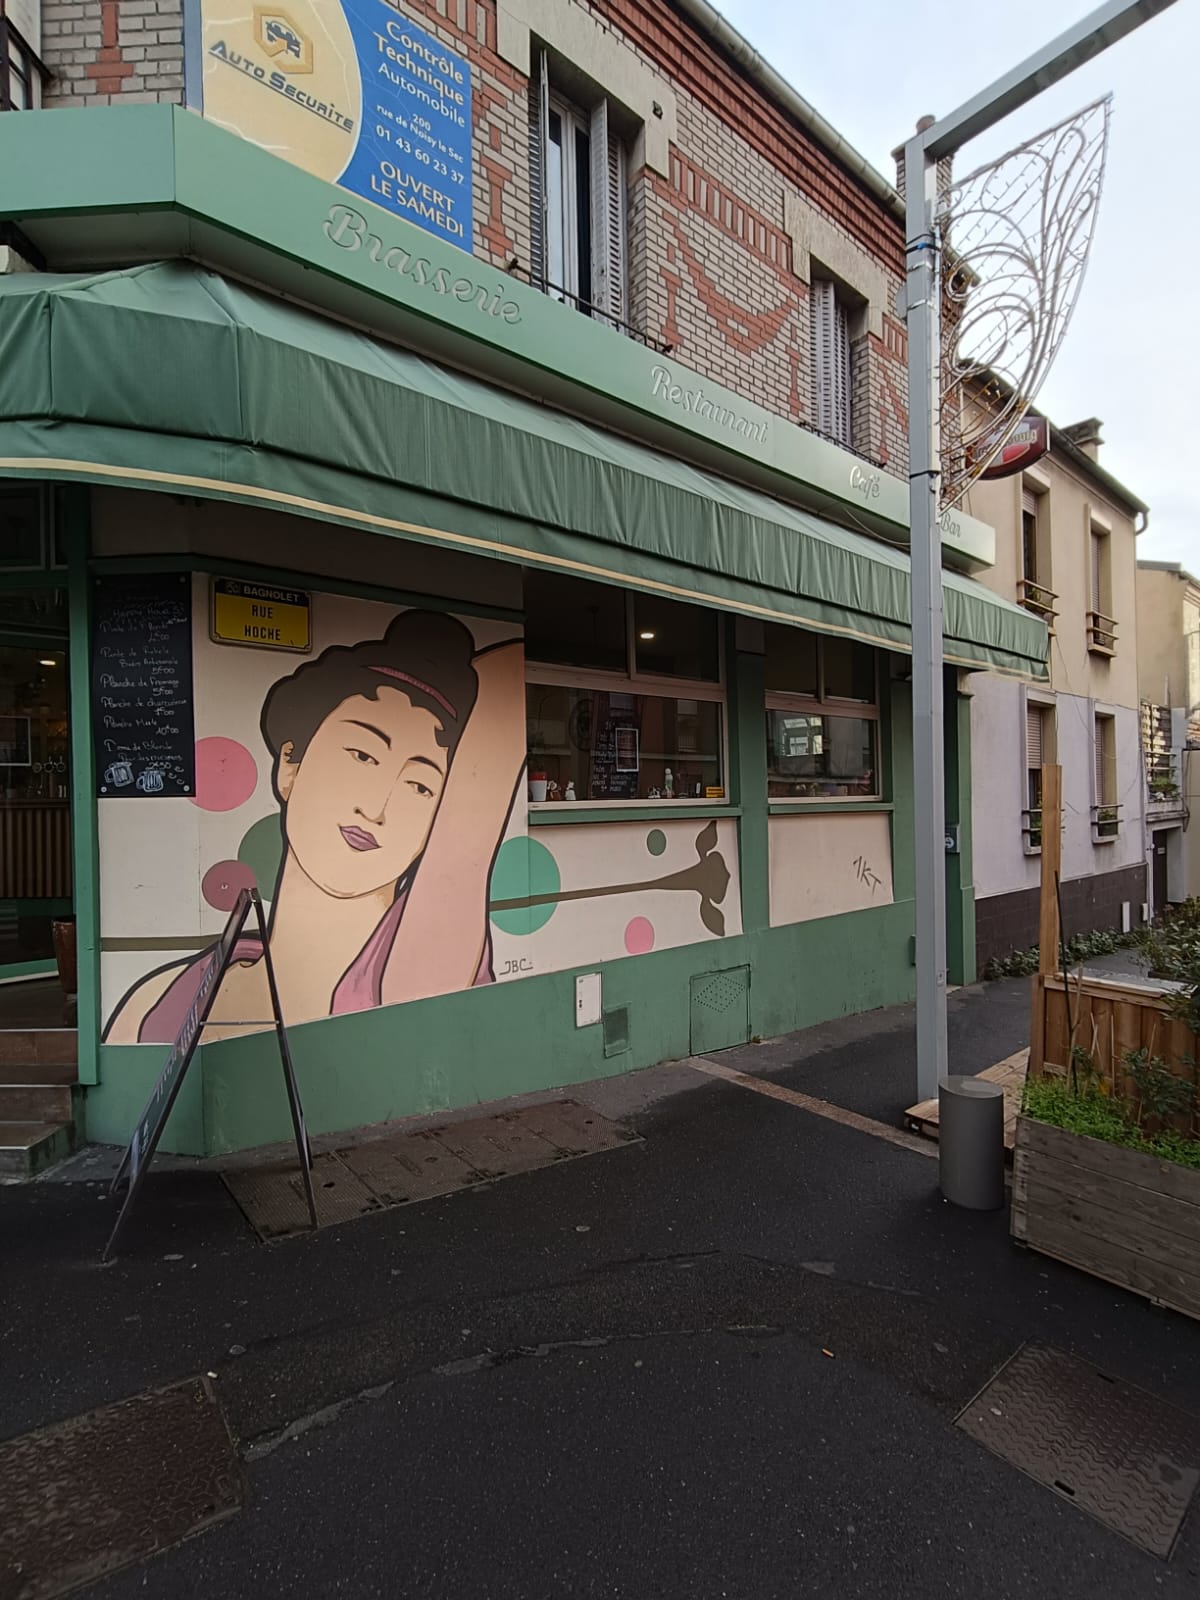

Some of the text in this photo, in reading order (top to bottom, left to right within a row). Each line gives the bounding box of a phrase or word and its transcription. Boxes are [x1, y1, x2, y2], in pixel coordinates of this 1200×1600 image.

[209, 40, 265, 79] AUTO
[373, 31, 464, 105] Technique
[386, 21, 464, 84] Contrôle
[378, 62, 465, 127] Automobile
[412, 113, 431, 131] 200
[376, 124, 465, 184] 01 43 60 23 37
[377, 105, 464, 163] rue de Noisy le Sec
[371, 174, 464, 238] LE SAMEDI
[380, 160, 455, 212] OUVERT
[322, 203, 522, 325] Brasserie
[651, 364, 961, 538] Restaurant Café Bar
[243, 585, 299, 603] BAGNOLET
[251, 604, 274, 619] RUE
[244, 624, 281, 641] HOCHE
